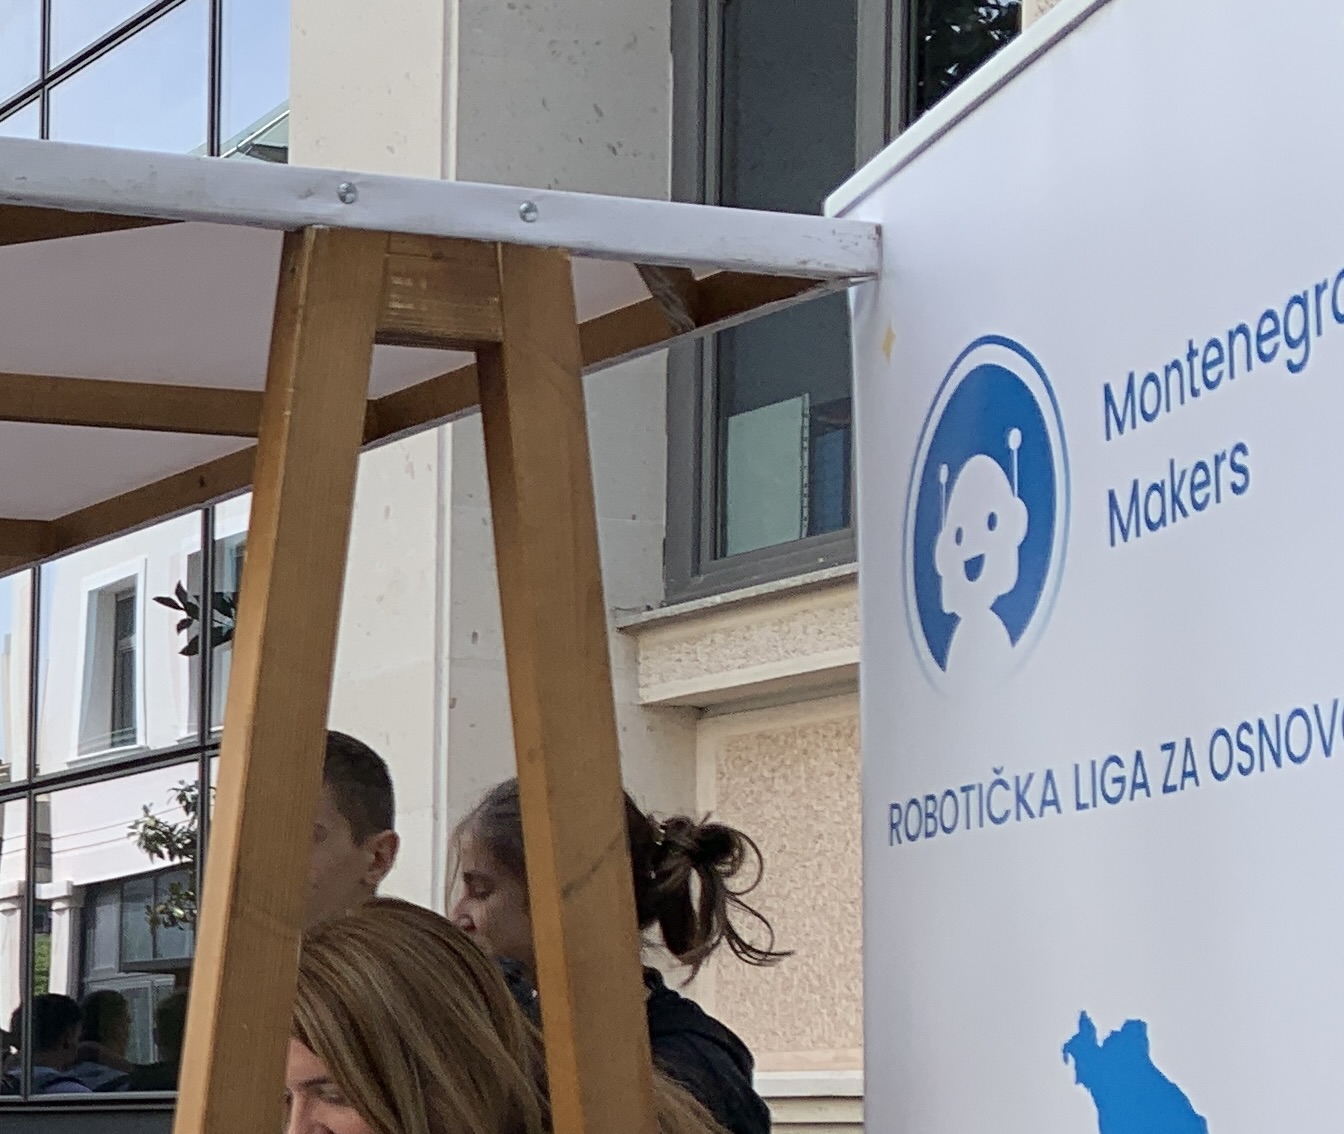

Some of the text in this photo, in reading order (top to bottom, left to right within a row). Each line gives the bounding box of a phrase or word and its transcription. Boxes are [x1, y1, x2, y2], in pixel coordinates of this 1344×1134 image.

[1103, 265, 1344, 442] Montenegro
[1108, 442, 1250, 547] Makers
[889, 698, 1344, 847] ROBOTIČKA LIGA ZA OSNOV
